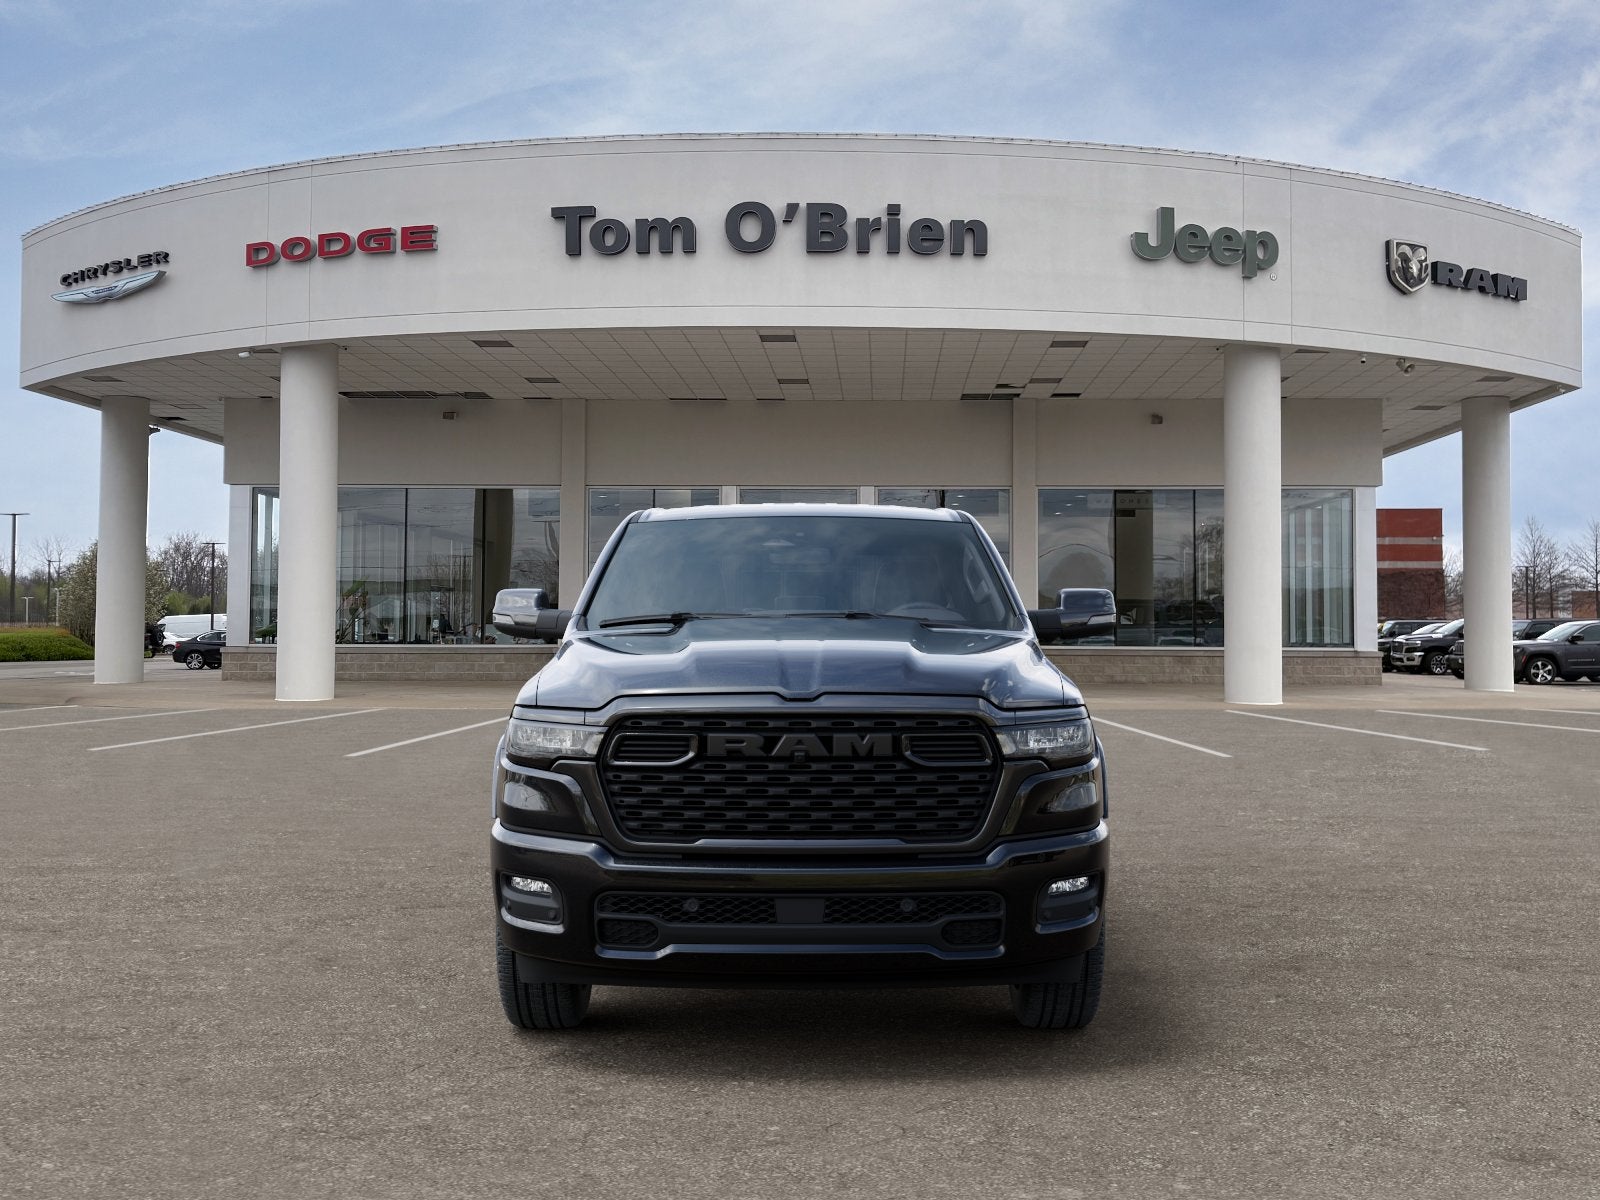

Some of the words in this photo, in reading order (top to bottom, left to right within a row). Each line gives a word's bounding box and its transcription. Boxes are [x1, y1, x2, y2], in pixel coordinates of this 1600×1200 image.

[245, 225, 438, 268] DODGE
[551, 205, 697, 256] Tom
[725, 201, 988, 256] O'Brien
[1130, 206, 1279, 278] Jeep
[60, 250, 170, 287] CHRYSLER
[1431, 261, 1528, 301] RAM
[706, 732, 894, 757] RAM
